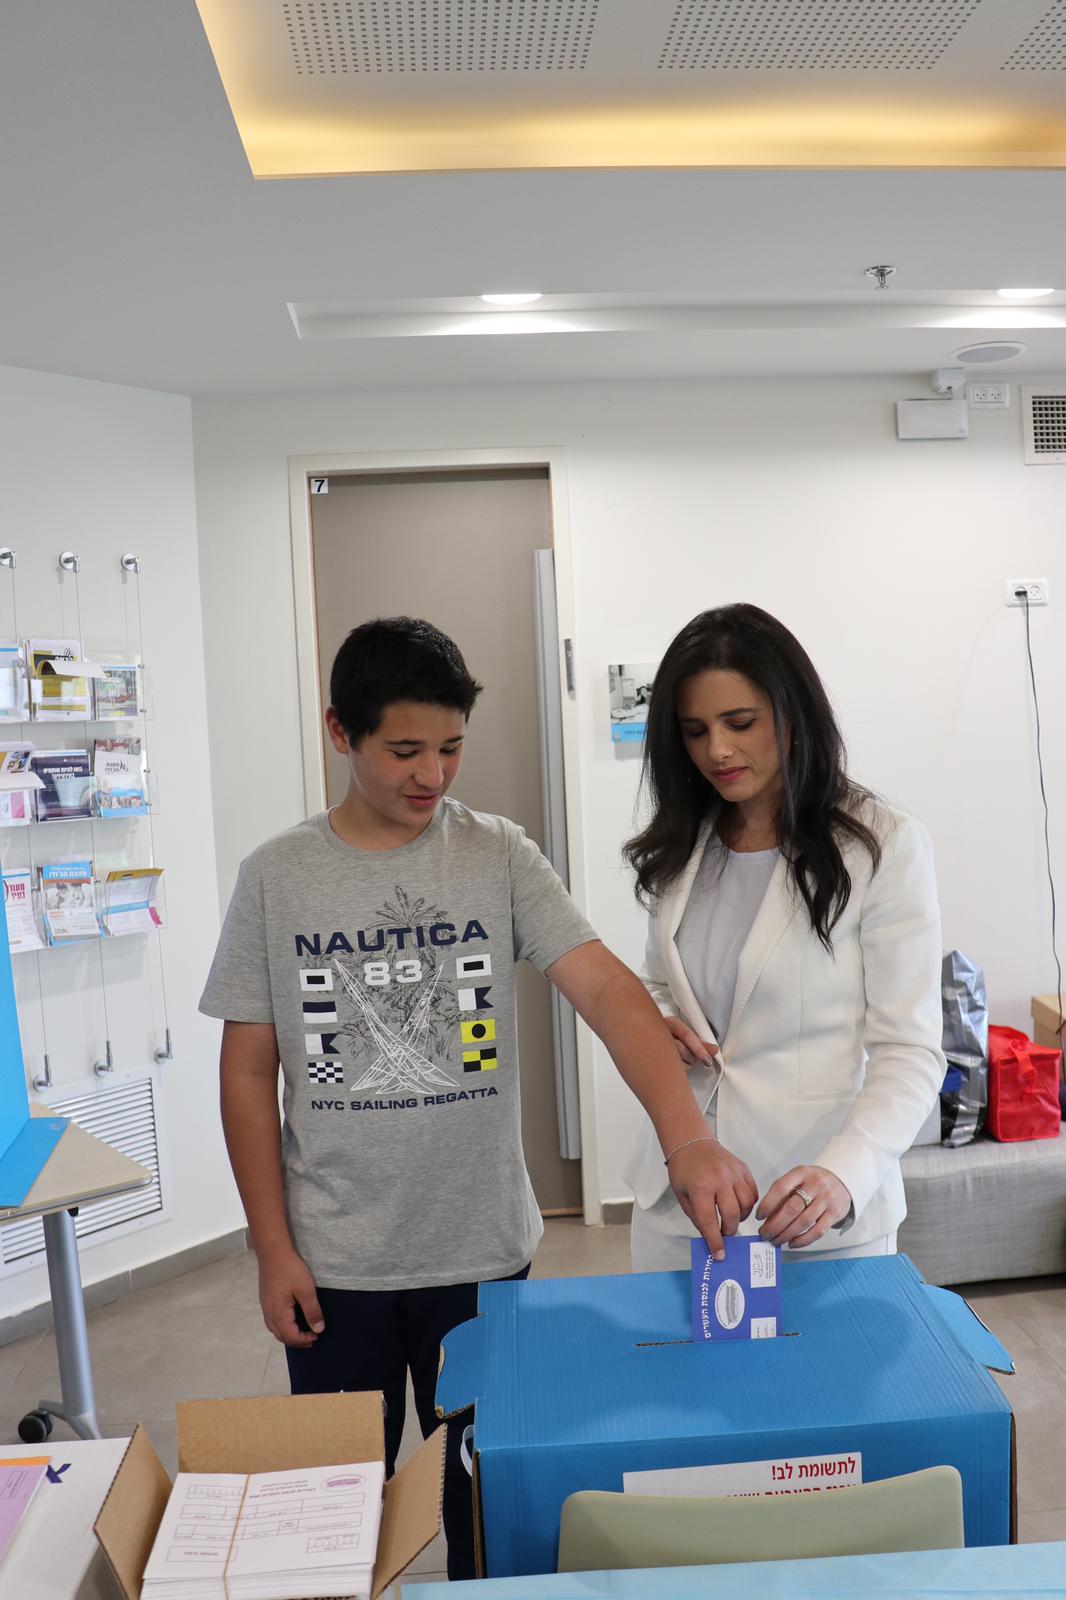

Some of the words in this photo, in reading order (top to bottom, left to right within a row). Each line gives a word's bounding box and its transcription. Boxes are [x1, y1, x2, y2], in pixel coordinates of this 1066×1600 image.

[314, 479, 326, 493] 7
[294, 919, 489, 957] NAUTICA
[363, 959, 423, 986] 83
[311, 1099, 345, 1111] NYC
[350, 1098, 418, 1111] SAILING
[424, 1086, 498, 1106] REGATTA
[700, 1283, 709, 1307] לכנסת
[701, 1309, 712, 1338] העשרים
[771, 1462, 794, 1481] לב!
[798, 1456, 856, 1479] לתשומת
